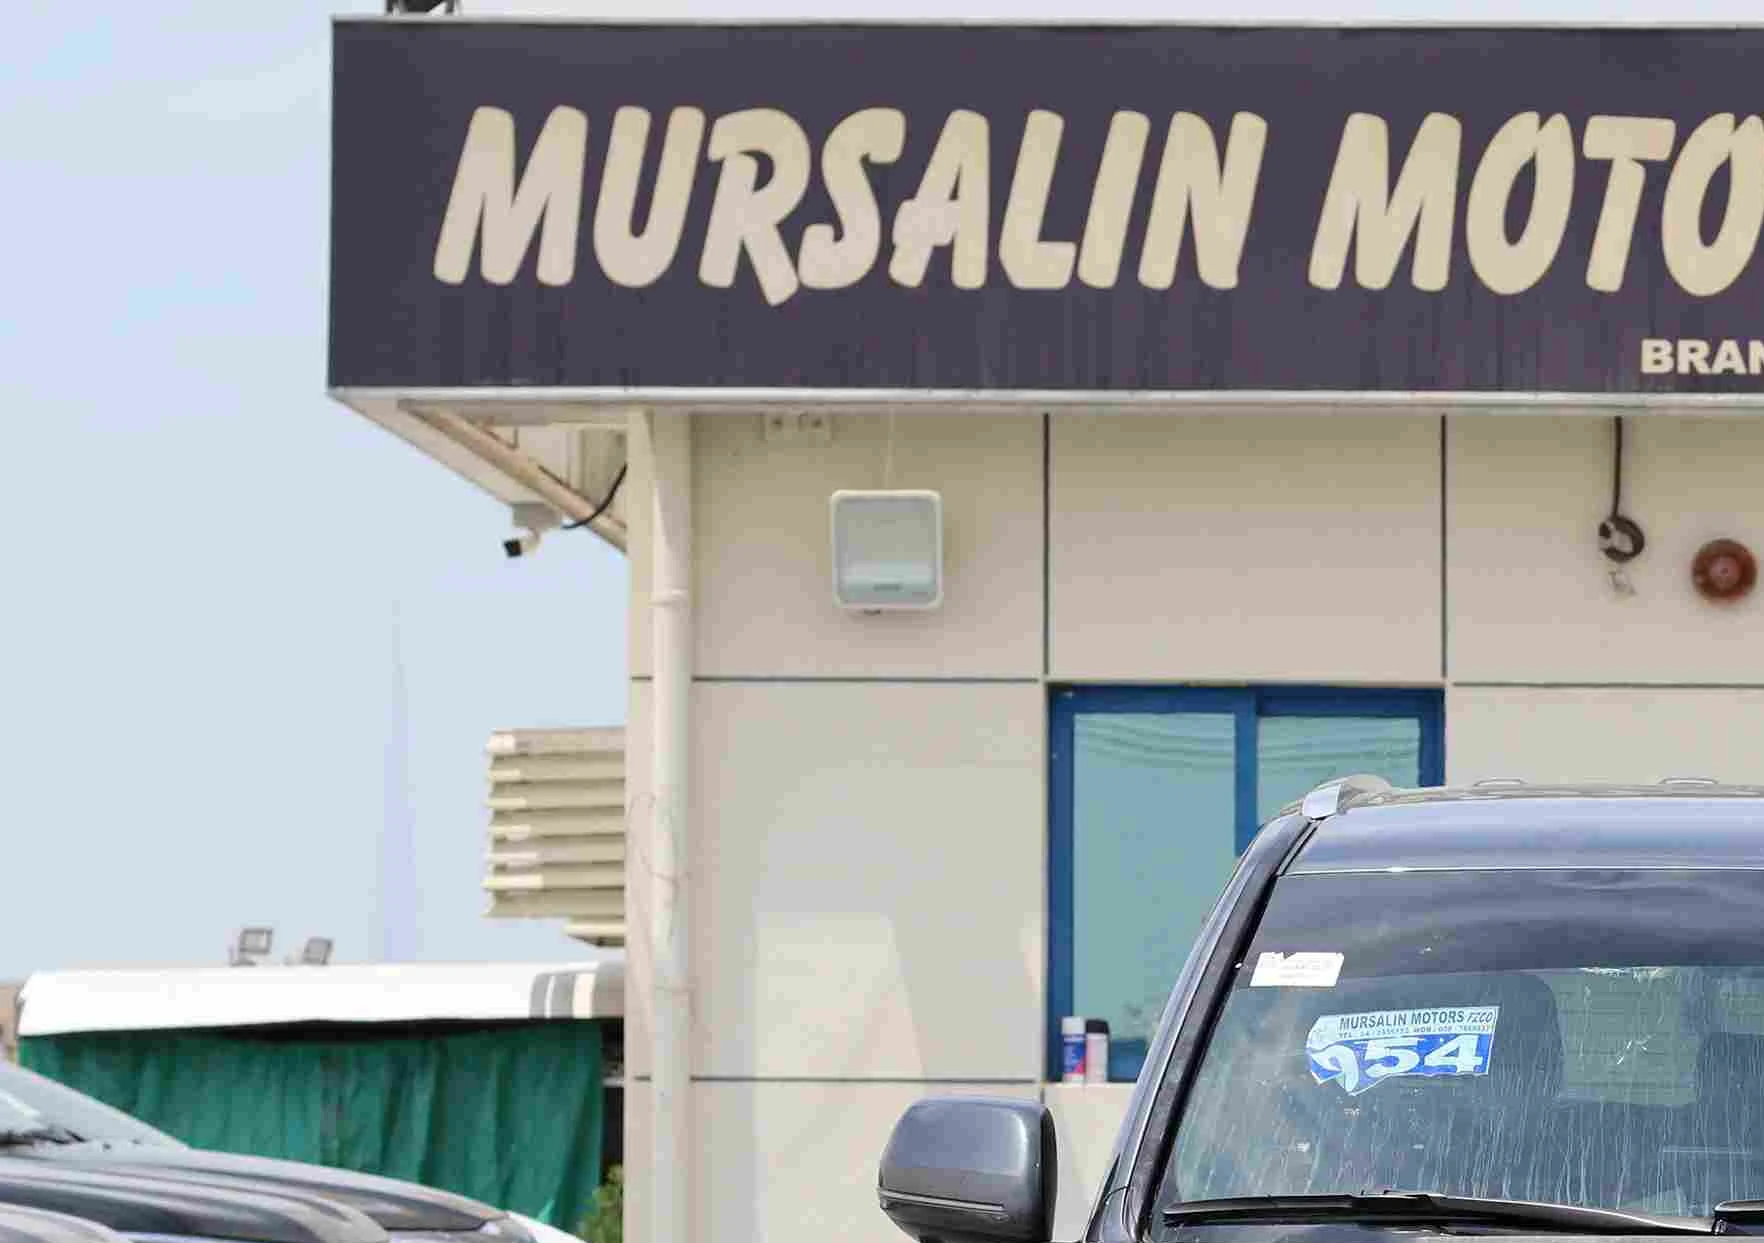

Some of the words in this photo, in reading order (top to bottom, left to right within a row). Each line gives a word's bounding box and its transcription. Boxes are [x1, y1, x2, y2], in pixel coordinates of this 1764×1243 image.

[433, 105, 1268, 306] MURSALIN
[1339, 1013, 1407, 1030] MURSALIN
[1411, 1010, 1465, 1025] MOTORS
